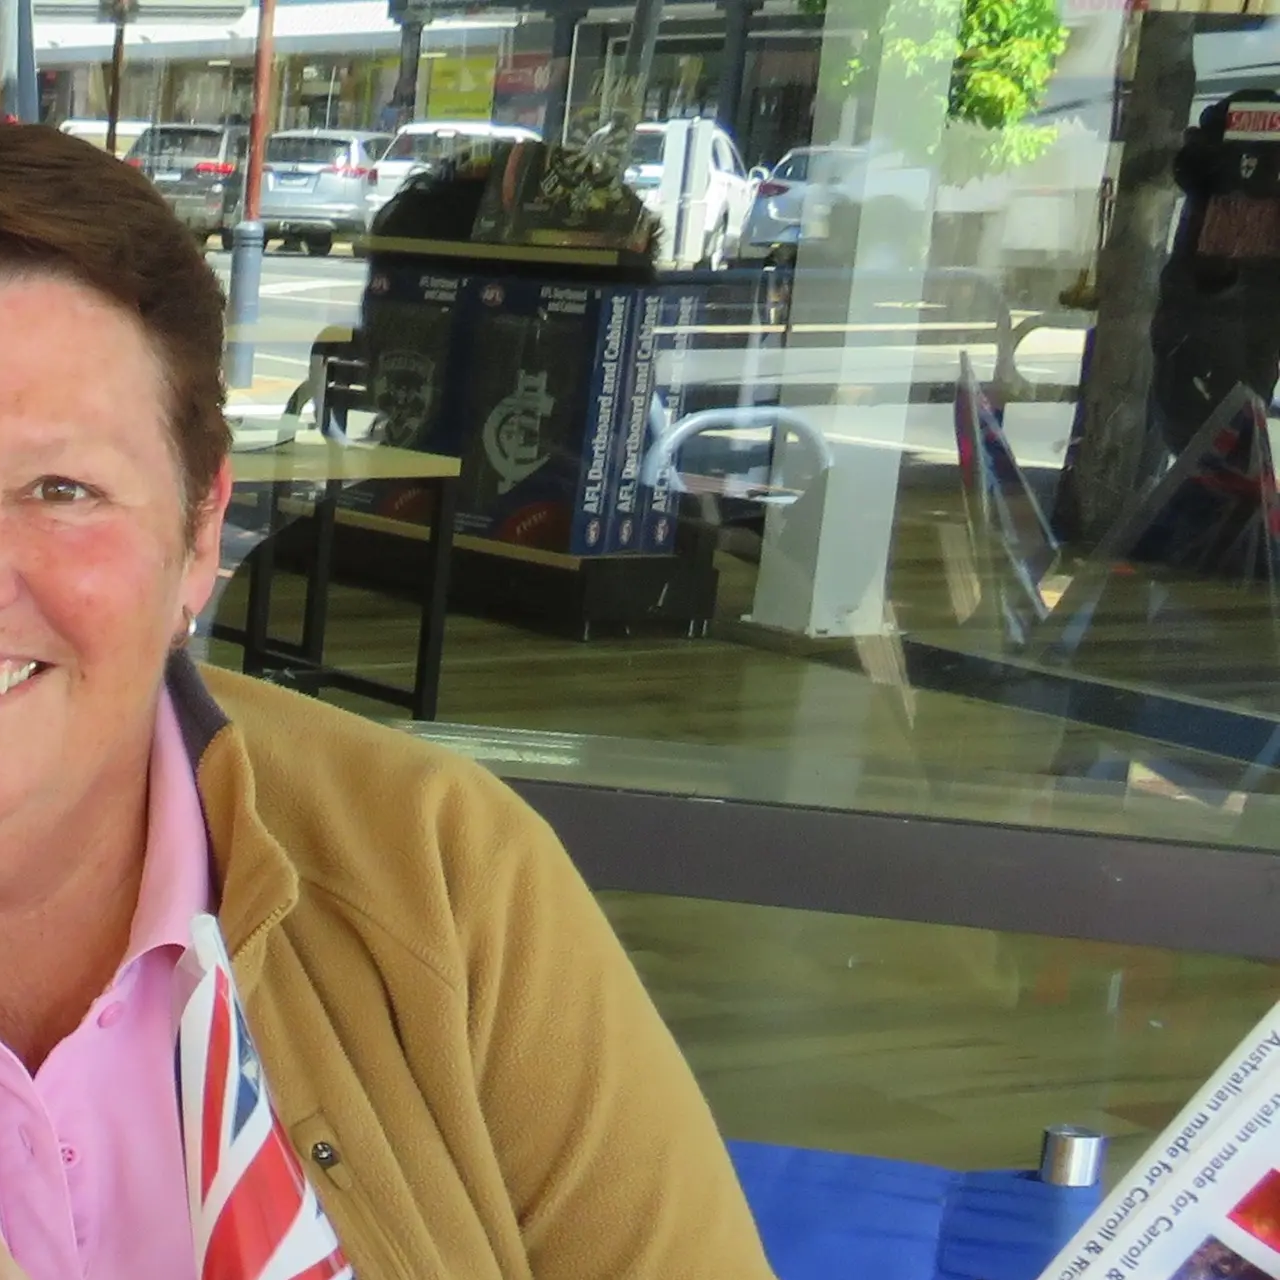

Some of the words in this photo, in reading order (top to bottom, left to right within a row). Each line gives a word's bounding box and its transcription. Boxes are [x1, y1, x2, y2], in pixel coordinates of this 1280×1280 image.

[605, 296, 626, 359] Cabinet
[603, 362, 617, 394] and
[635, 362, 649, 394] and
[588, 396, 612, 480] Dartboard
[622, 396, 645, 480] Dartboard
[584, 484, 603, 513] AFL
[618, 485, 637, 513] AFL
[1166, 1111, 1209, 1154] made
[1144, 1159, 1172, 1187] for
[1195, 1144, 1239, 1188] made
[1096, 1185, 1150, 1241] Carroll
[1174, 1190, 1198, 1216] for
[1087, 1237, 1103, 1255] &
[1123, 1216, 1174, 1270] Carroll
